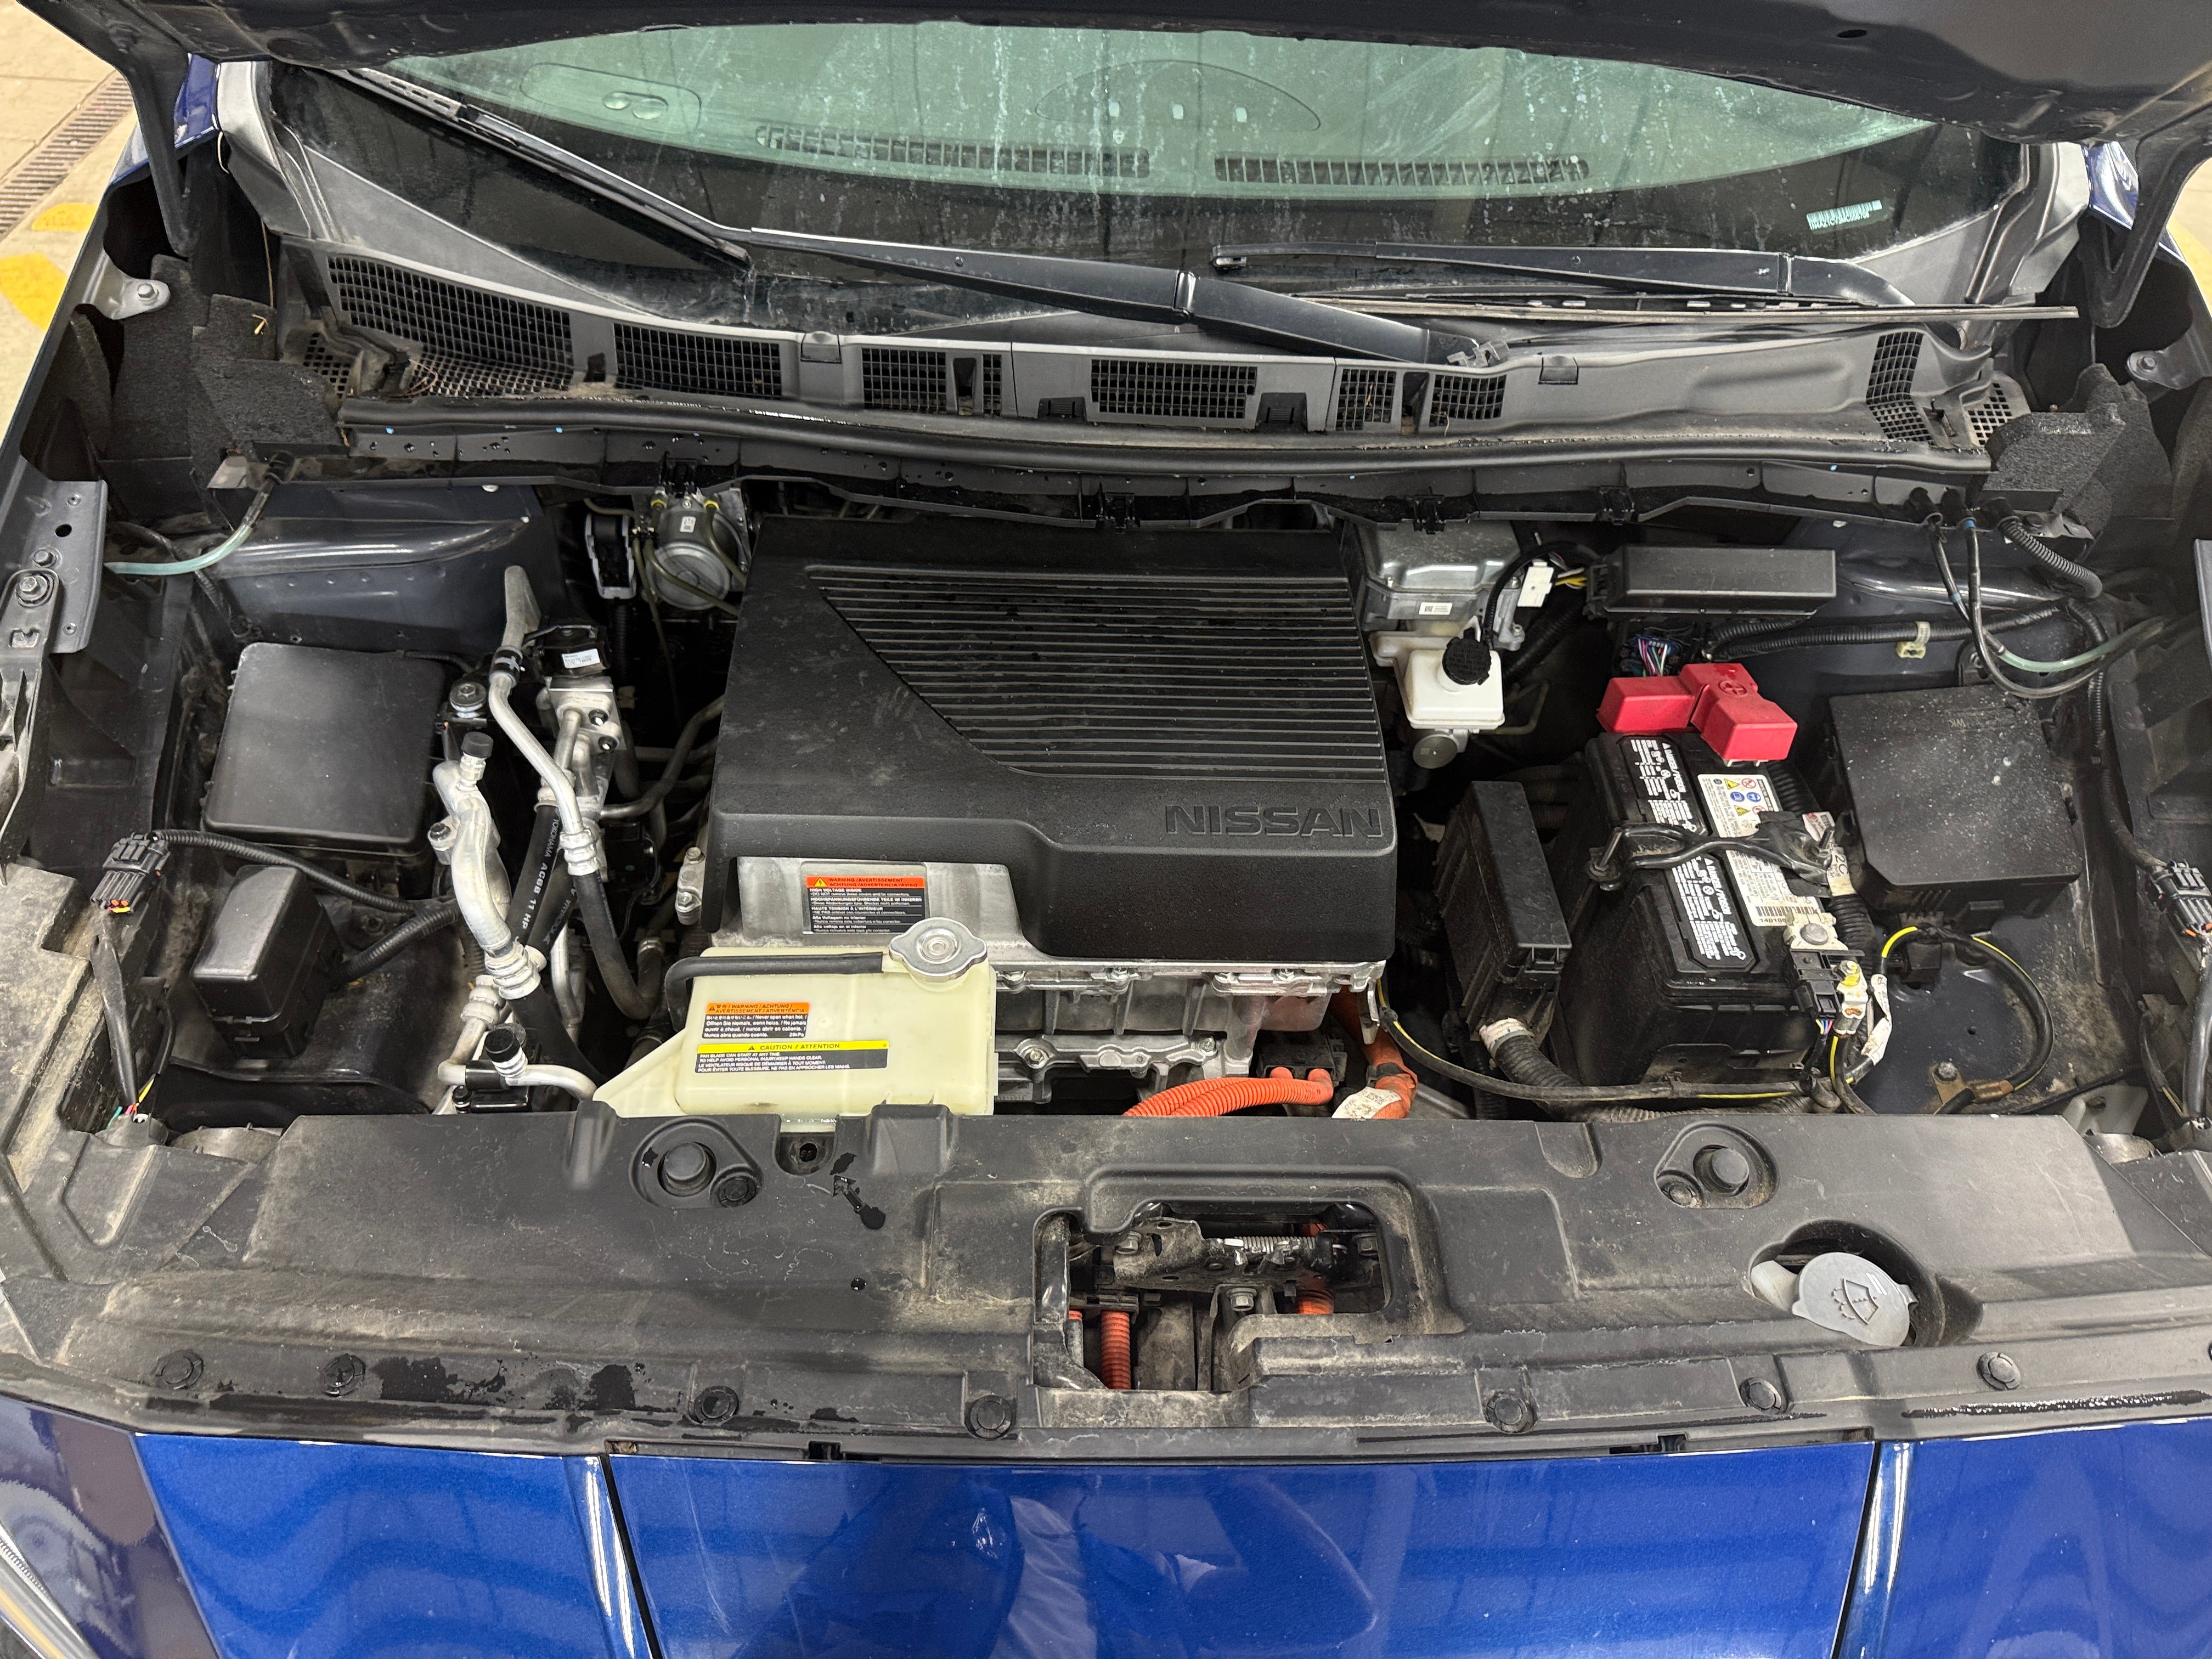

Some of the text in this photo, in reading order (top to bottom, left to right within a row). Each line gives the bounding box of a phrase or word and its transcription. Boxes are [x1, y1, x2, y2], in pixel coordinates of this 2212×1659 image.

[1165, 805, 1384, 837] NISSAN
[545, 819, 560, 857] YOKOHAMA
[1835, 855, 1848, 874] 2C
[528, 899, 537, 910] 11
[522, 913, 532, 929] HP
